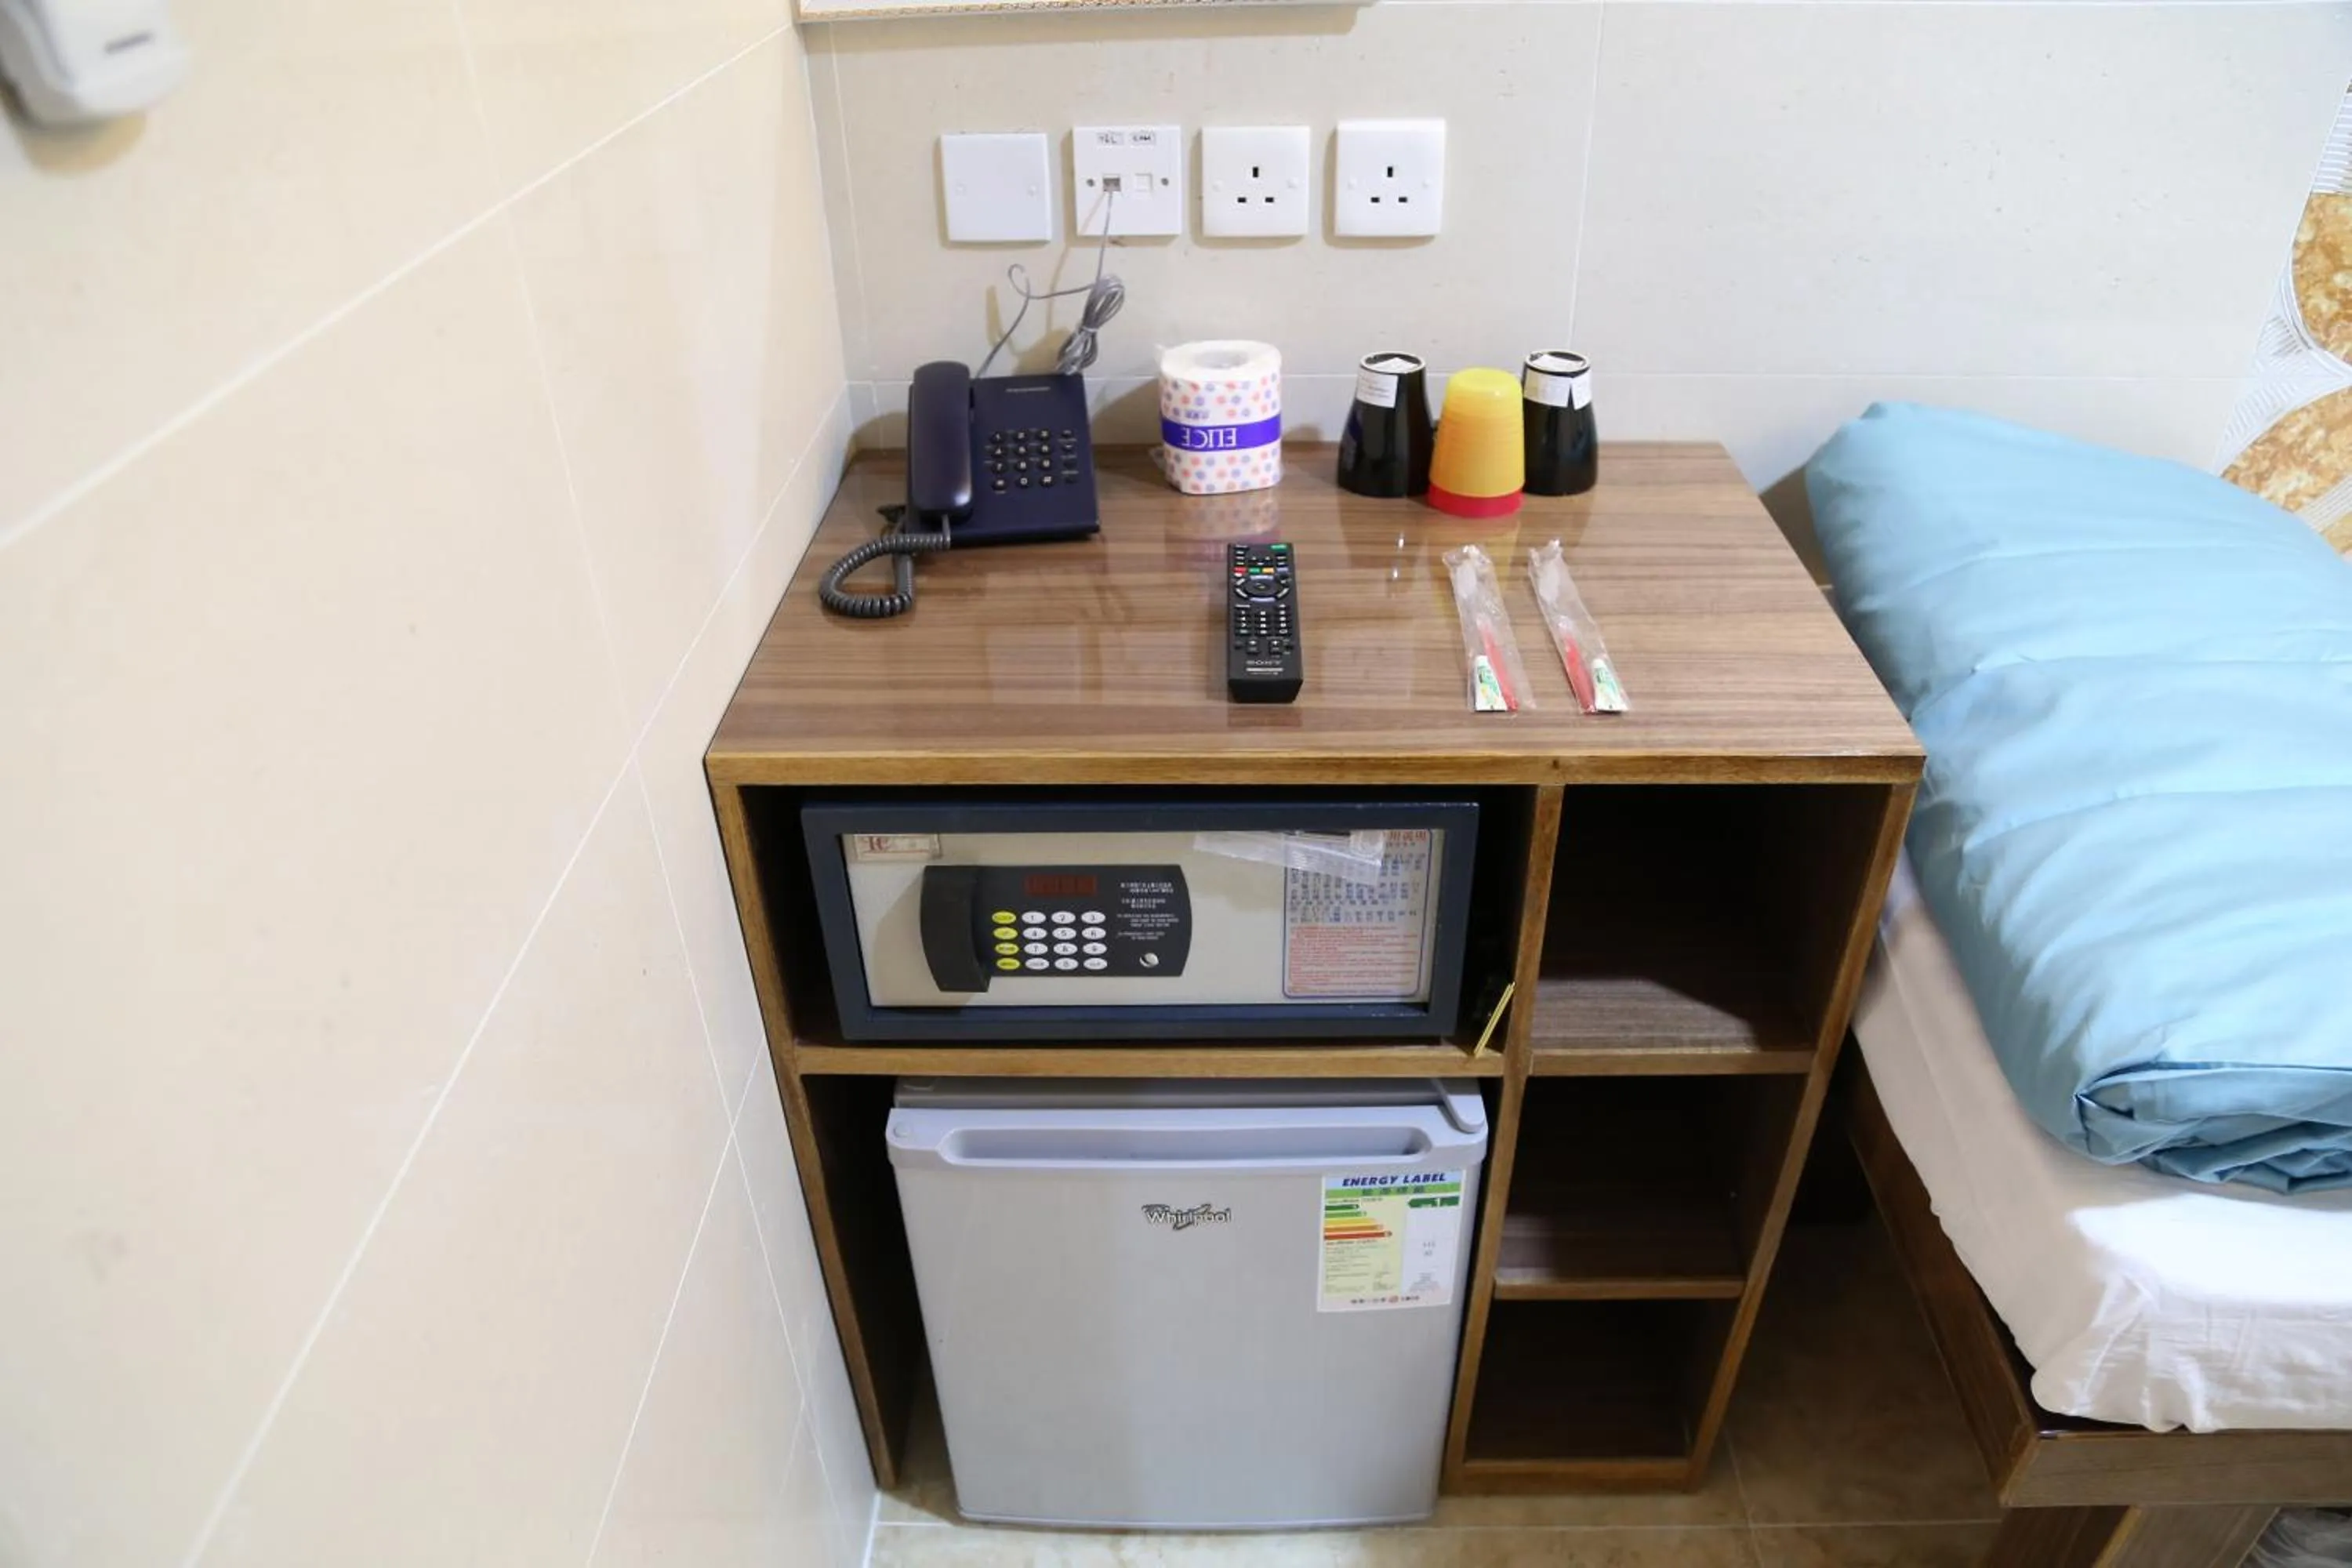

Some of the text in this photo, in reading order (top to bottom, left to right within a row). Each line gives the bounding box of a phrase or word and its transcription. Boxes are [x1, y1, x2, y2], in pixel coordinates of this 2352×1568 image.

[1181, 426, 1237, 448] ELICE
[1342, 1173, 1446, 1187] ENERGY LABEL
[1142, 1203, 1232, 1229] Whirlpool
